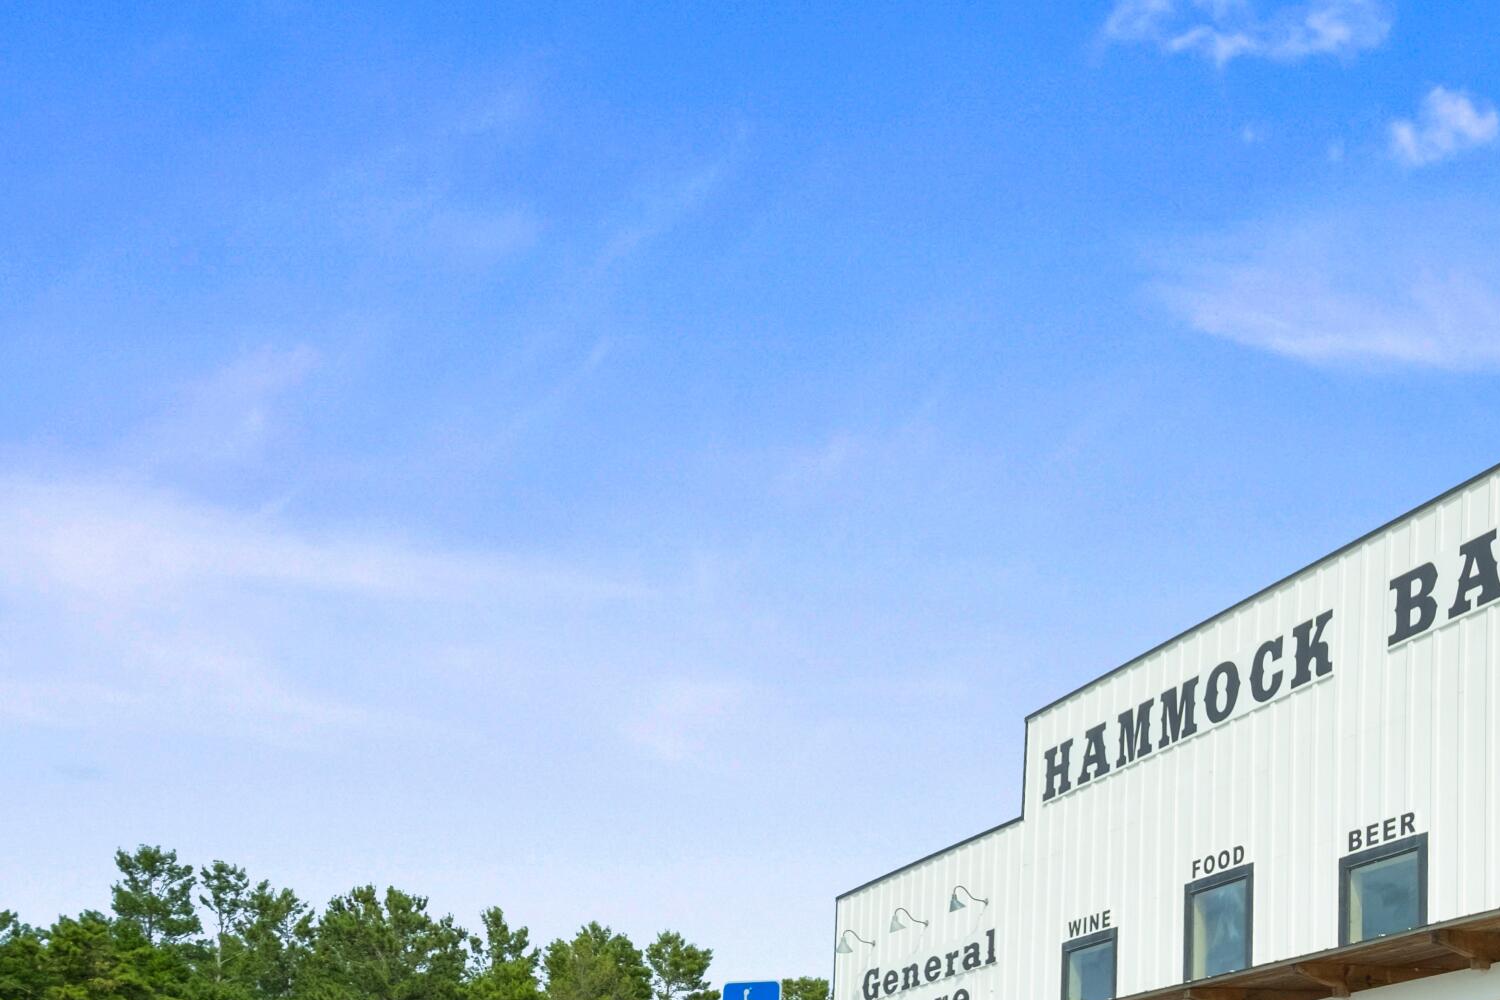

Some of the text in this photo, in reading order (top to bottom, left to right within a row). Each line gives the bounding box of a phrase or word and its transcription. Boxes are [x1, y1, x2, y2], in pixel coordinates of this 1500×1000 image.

[1043, 609, 1333, 801] HAMMOCK
[1348, 812, 1416, 852] BEER
[1192, 845, 1245, 879] FOOD
[1068, 910, 1111, 938] WINE
